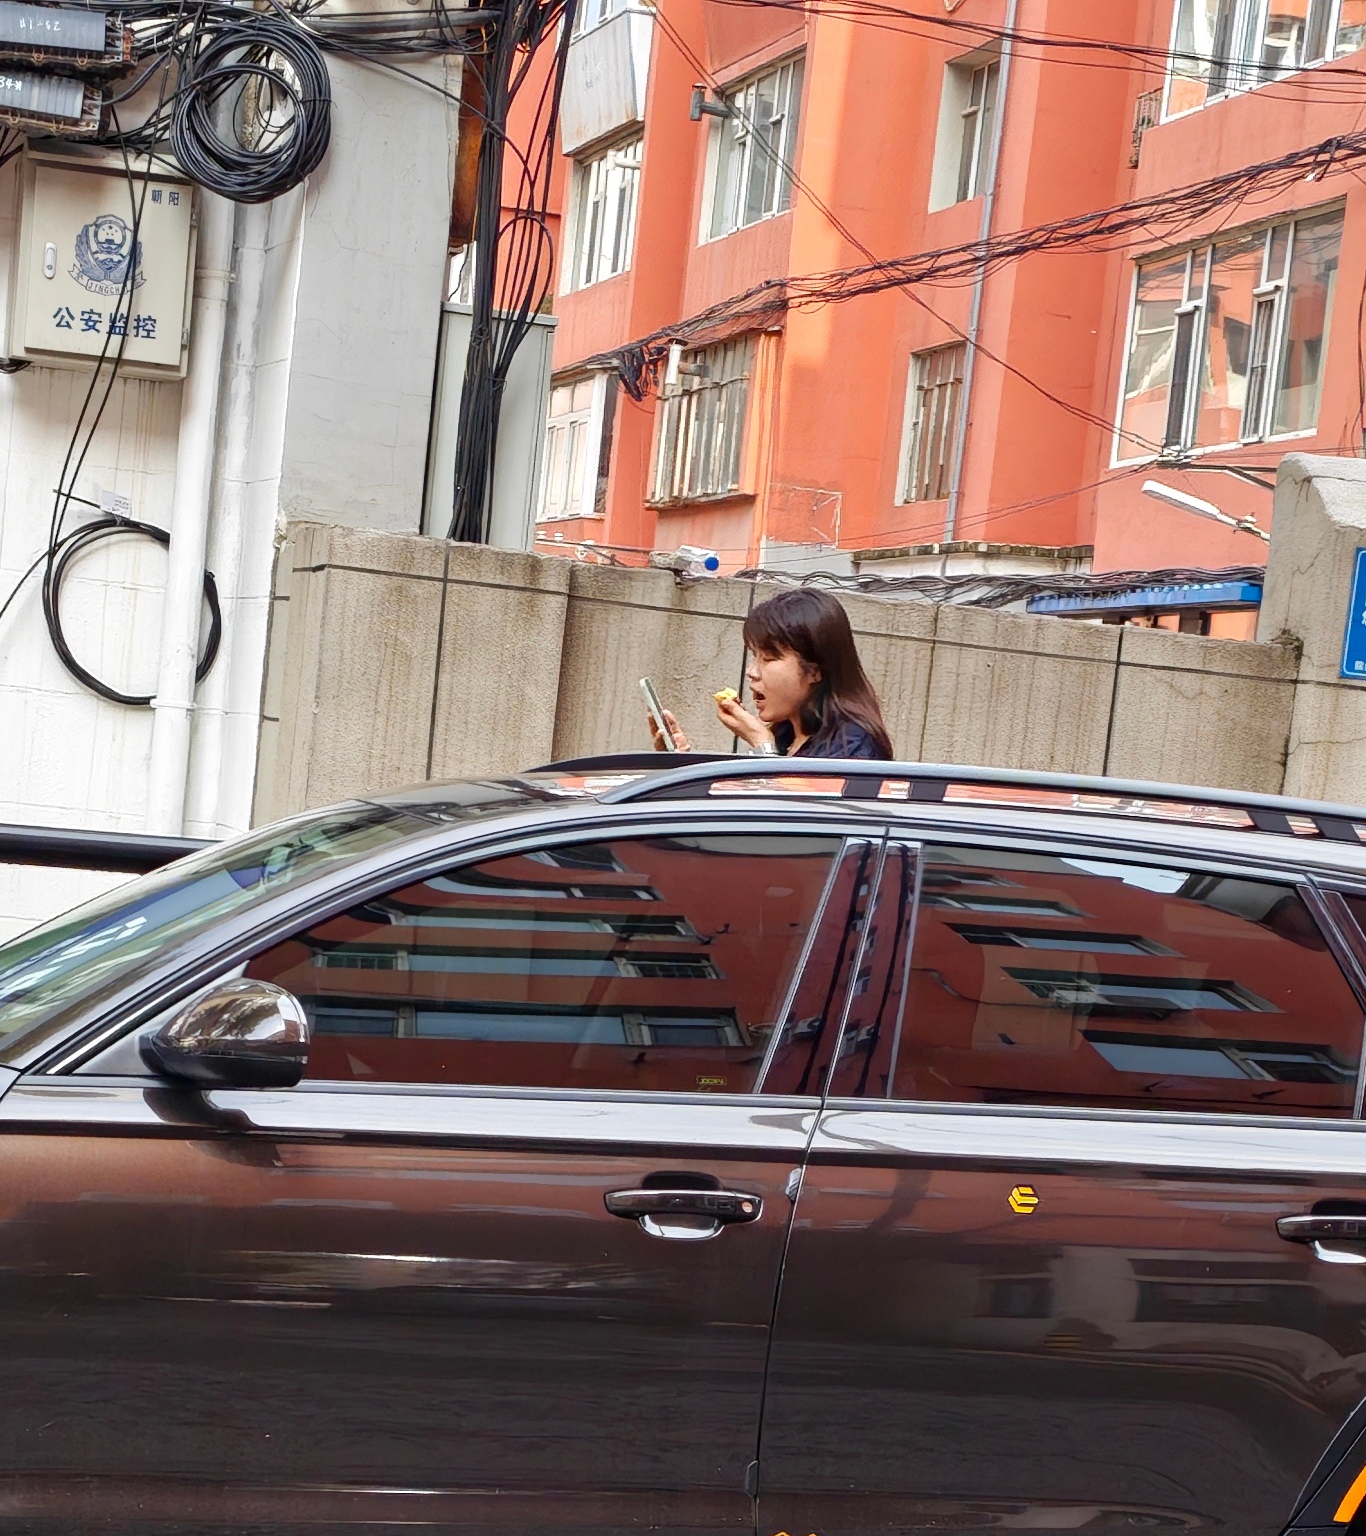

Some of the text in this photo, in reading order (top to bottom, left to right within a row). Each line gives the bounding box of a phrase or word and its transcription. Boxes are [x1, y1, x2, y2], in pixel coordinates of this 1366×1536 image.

[151, 189, 180, 206] 朝阳
[52, 306, 157, 340] 公安监控
